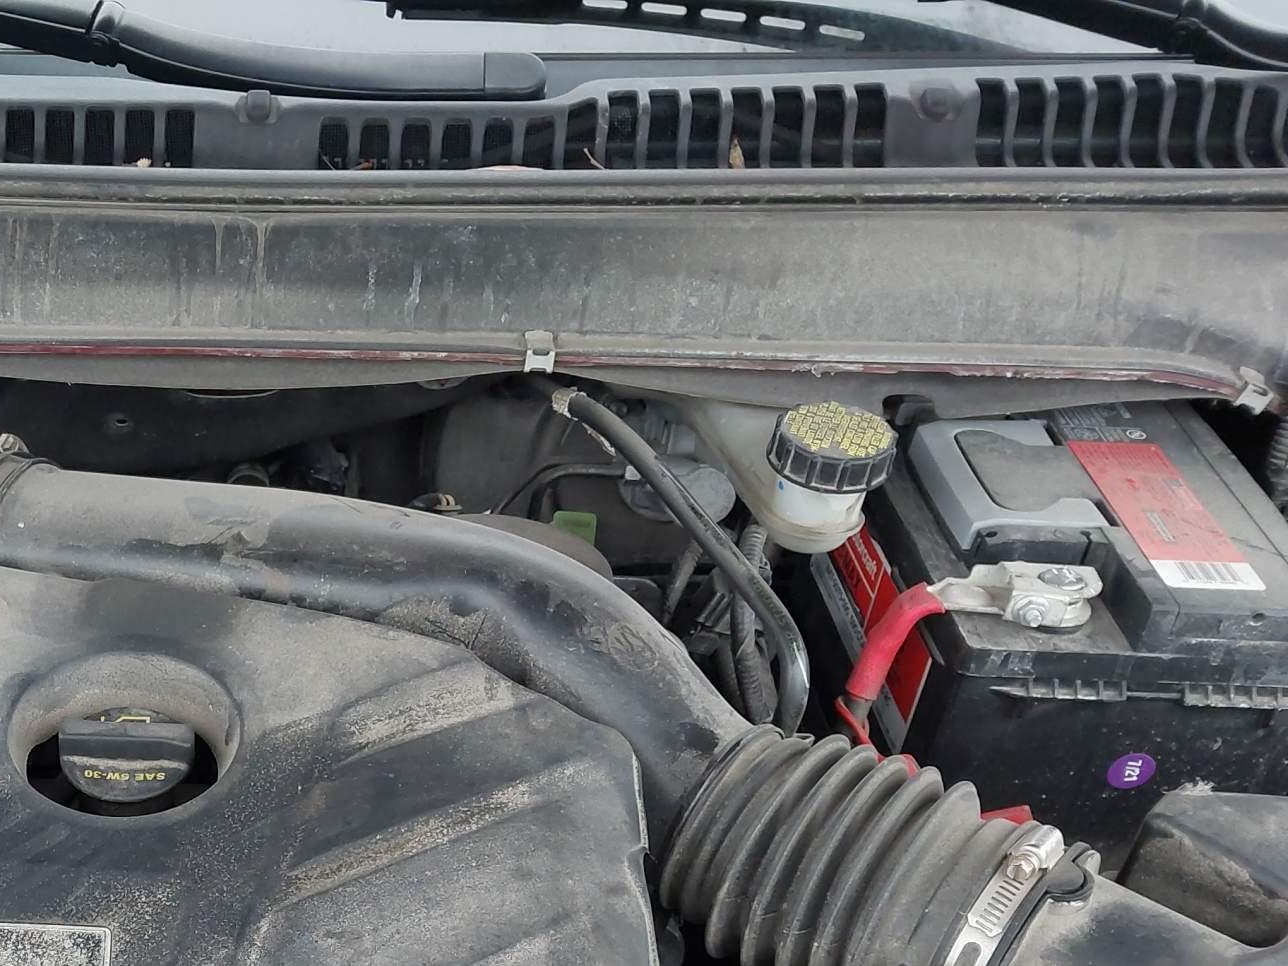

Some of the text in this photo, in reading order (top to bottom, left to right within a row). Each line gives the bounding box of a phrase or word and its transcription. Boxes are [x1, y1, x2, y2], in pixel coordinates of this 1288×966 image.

[84, 769, 166, 781] SAE 5W-30
[1123, 759, 1143, 782] 7/21
